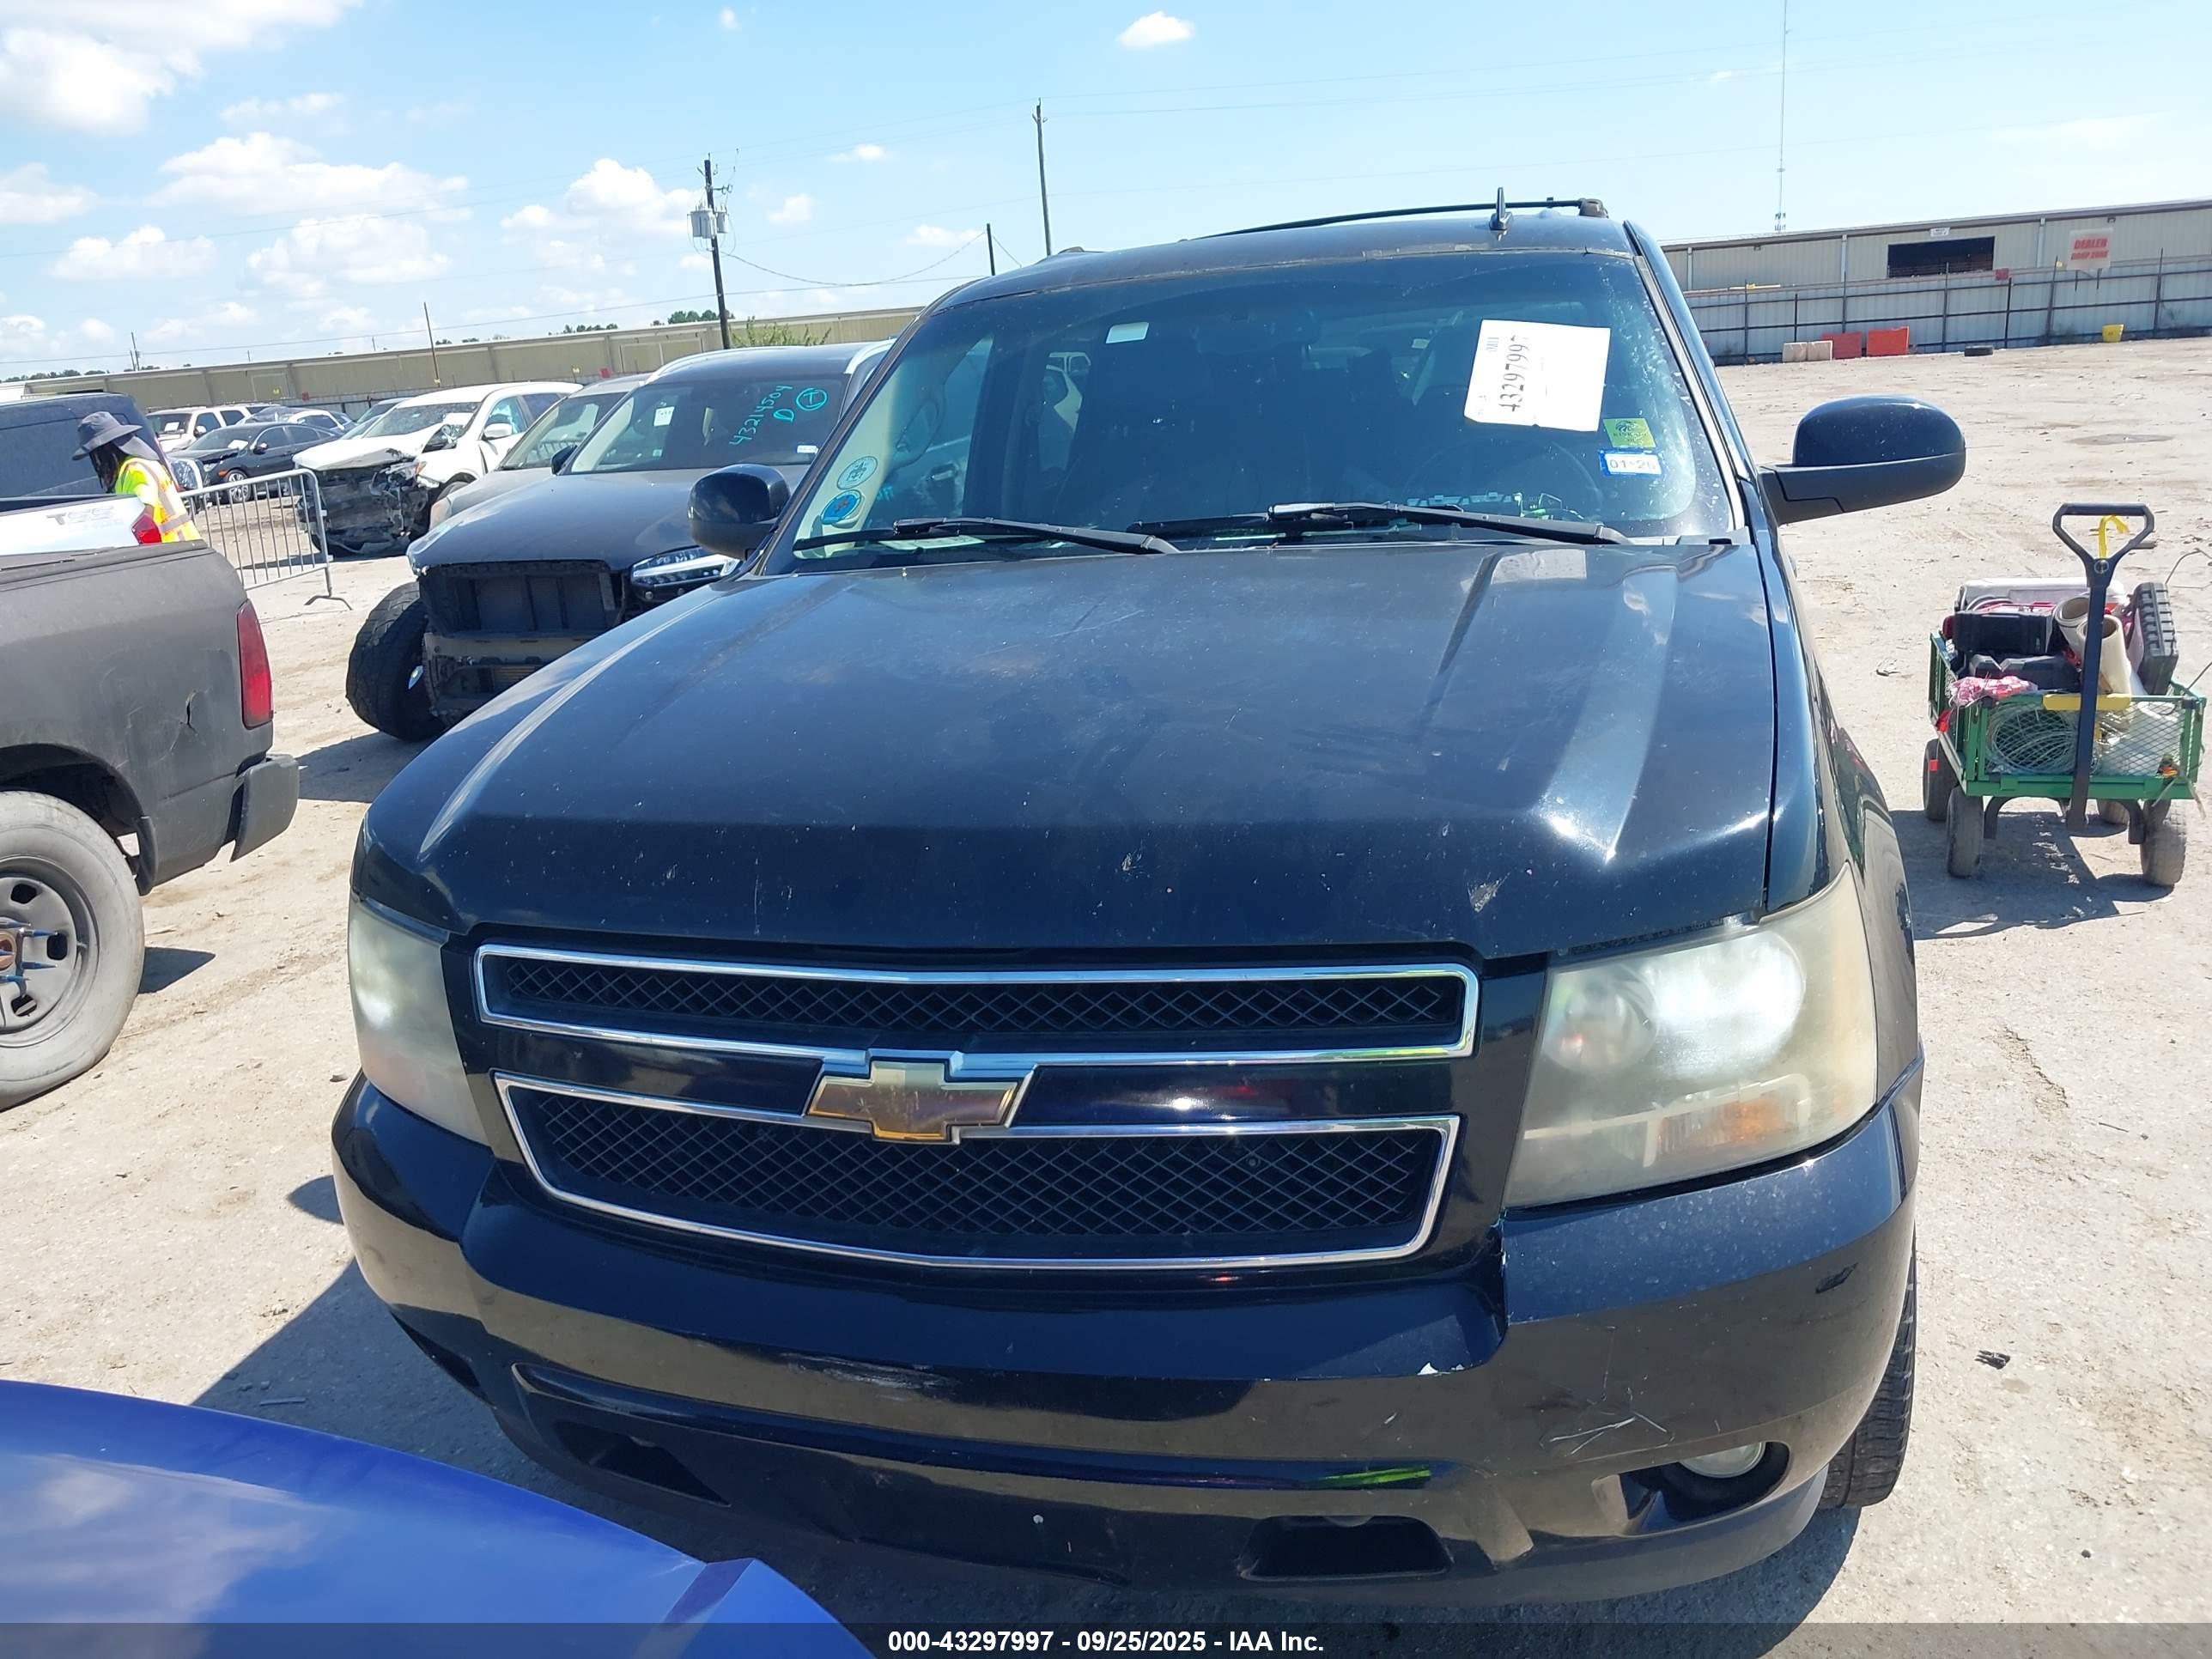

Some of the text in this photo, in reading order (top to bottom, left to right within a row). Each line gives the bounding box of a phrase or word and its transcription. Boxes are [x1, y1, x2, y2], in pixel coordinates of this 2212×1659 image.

[2074, 238, 2108, 249] DEALER
[1498, 335, 1530, 412] 43297997
[728, 385, 793, 445] 43214504
